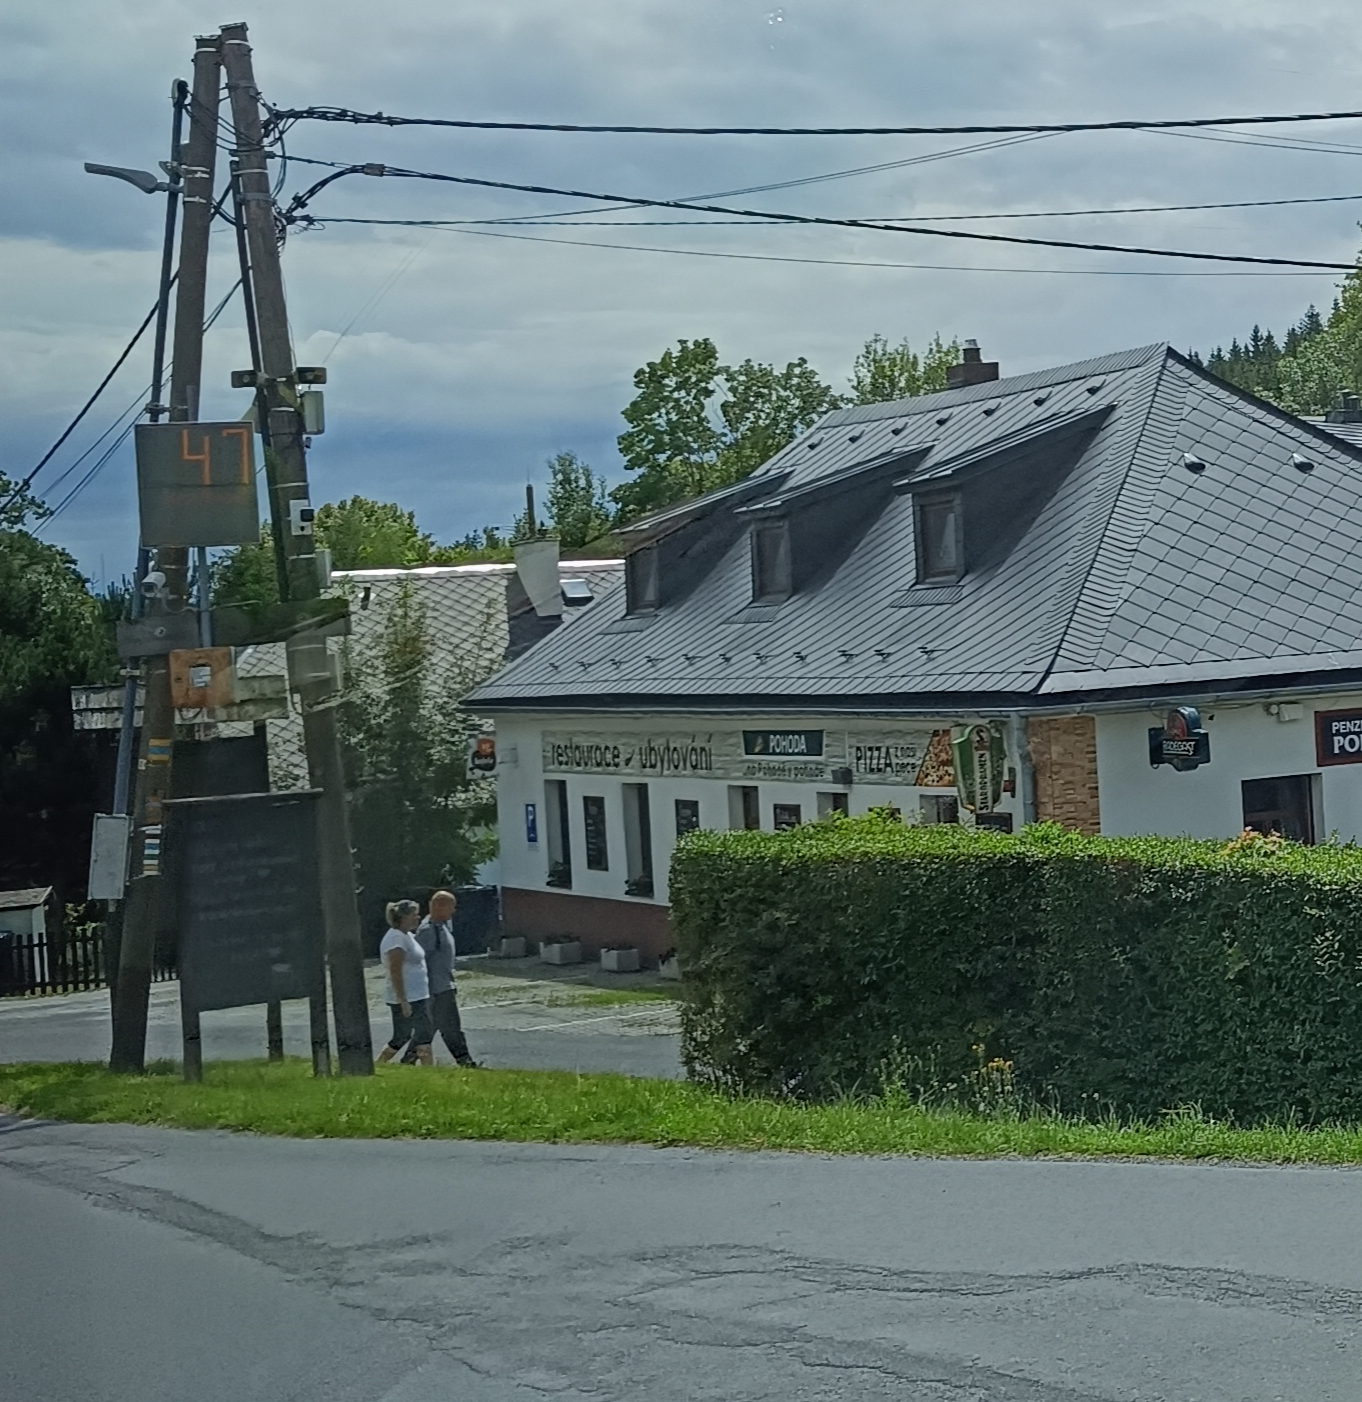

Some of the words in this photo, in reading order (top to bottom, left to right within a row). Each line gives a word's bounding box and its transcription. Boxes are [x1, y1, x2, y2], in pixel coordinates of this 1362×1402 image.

[181, 429, 250, 486] 47
[551, 737, 621, 768] restaurace
[639, 734, 713, 776] ubytování
[769, 734, 808, 753] POHODA
[855, 745, 895, 774] PIZZA
